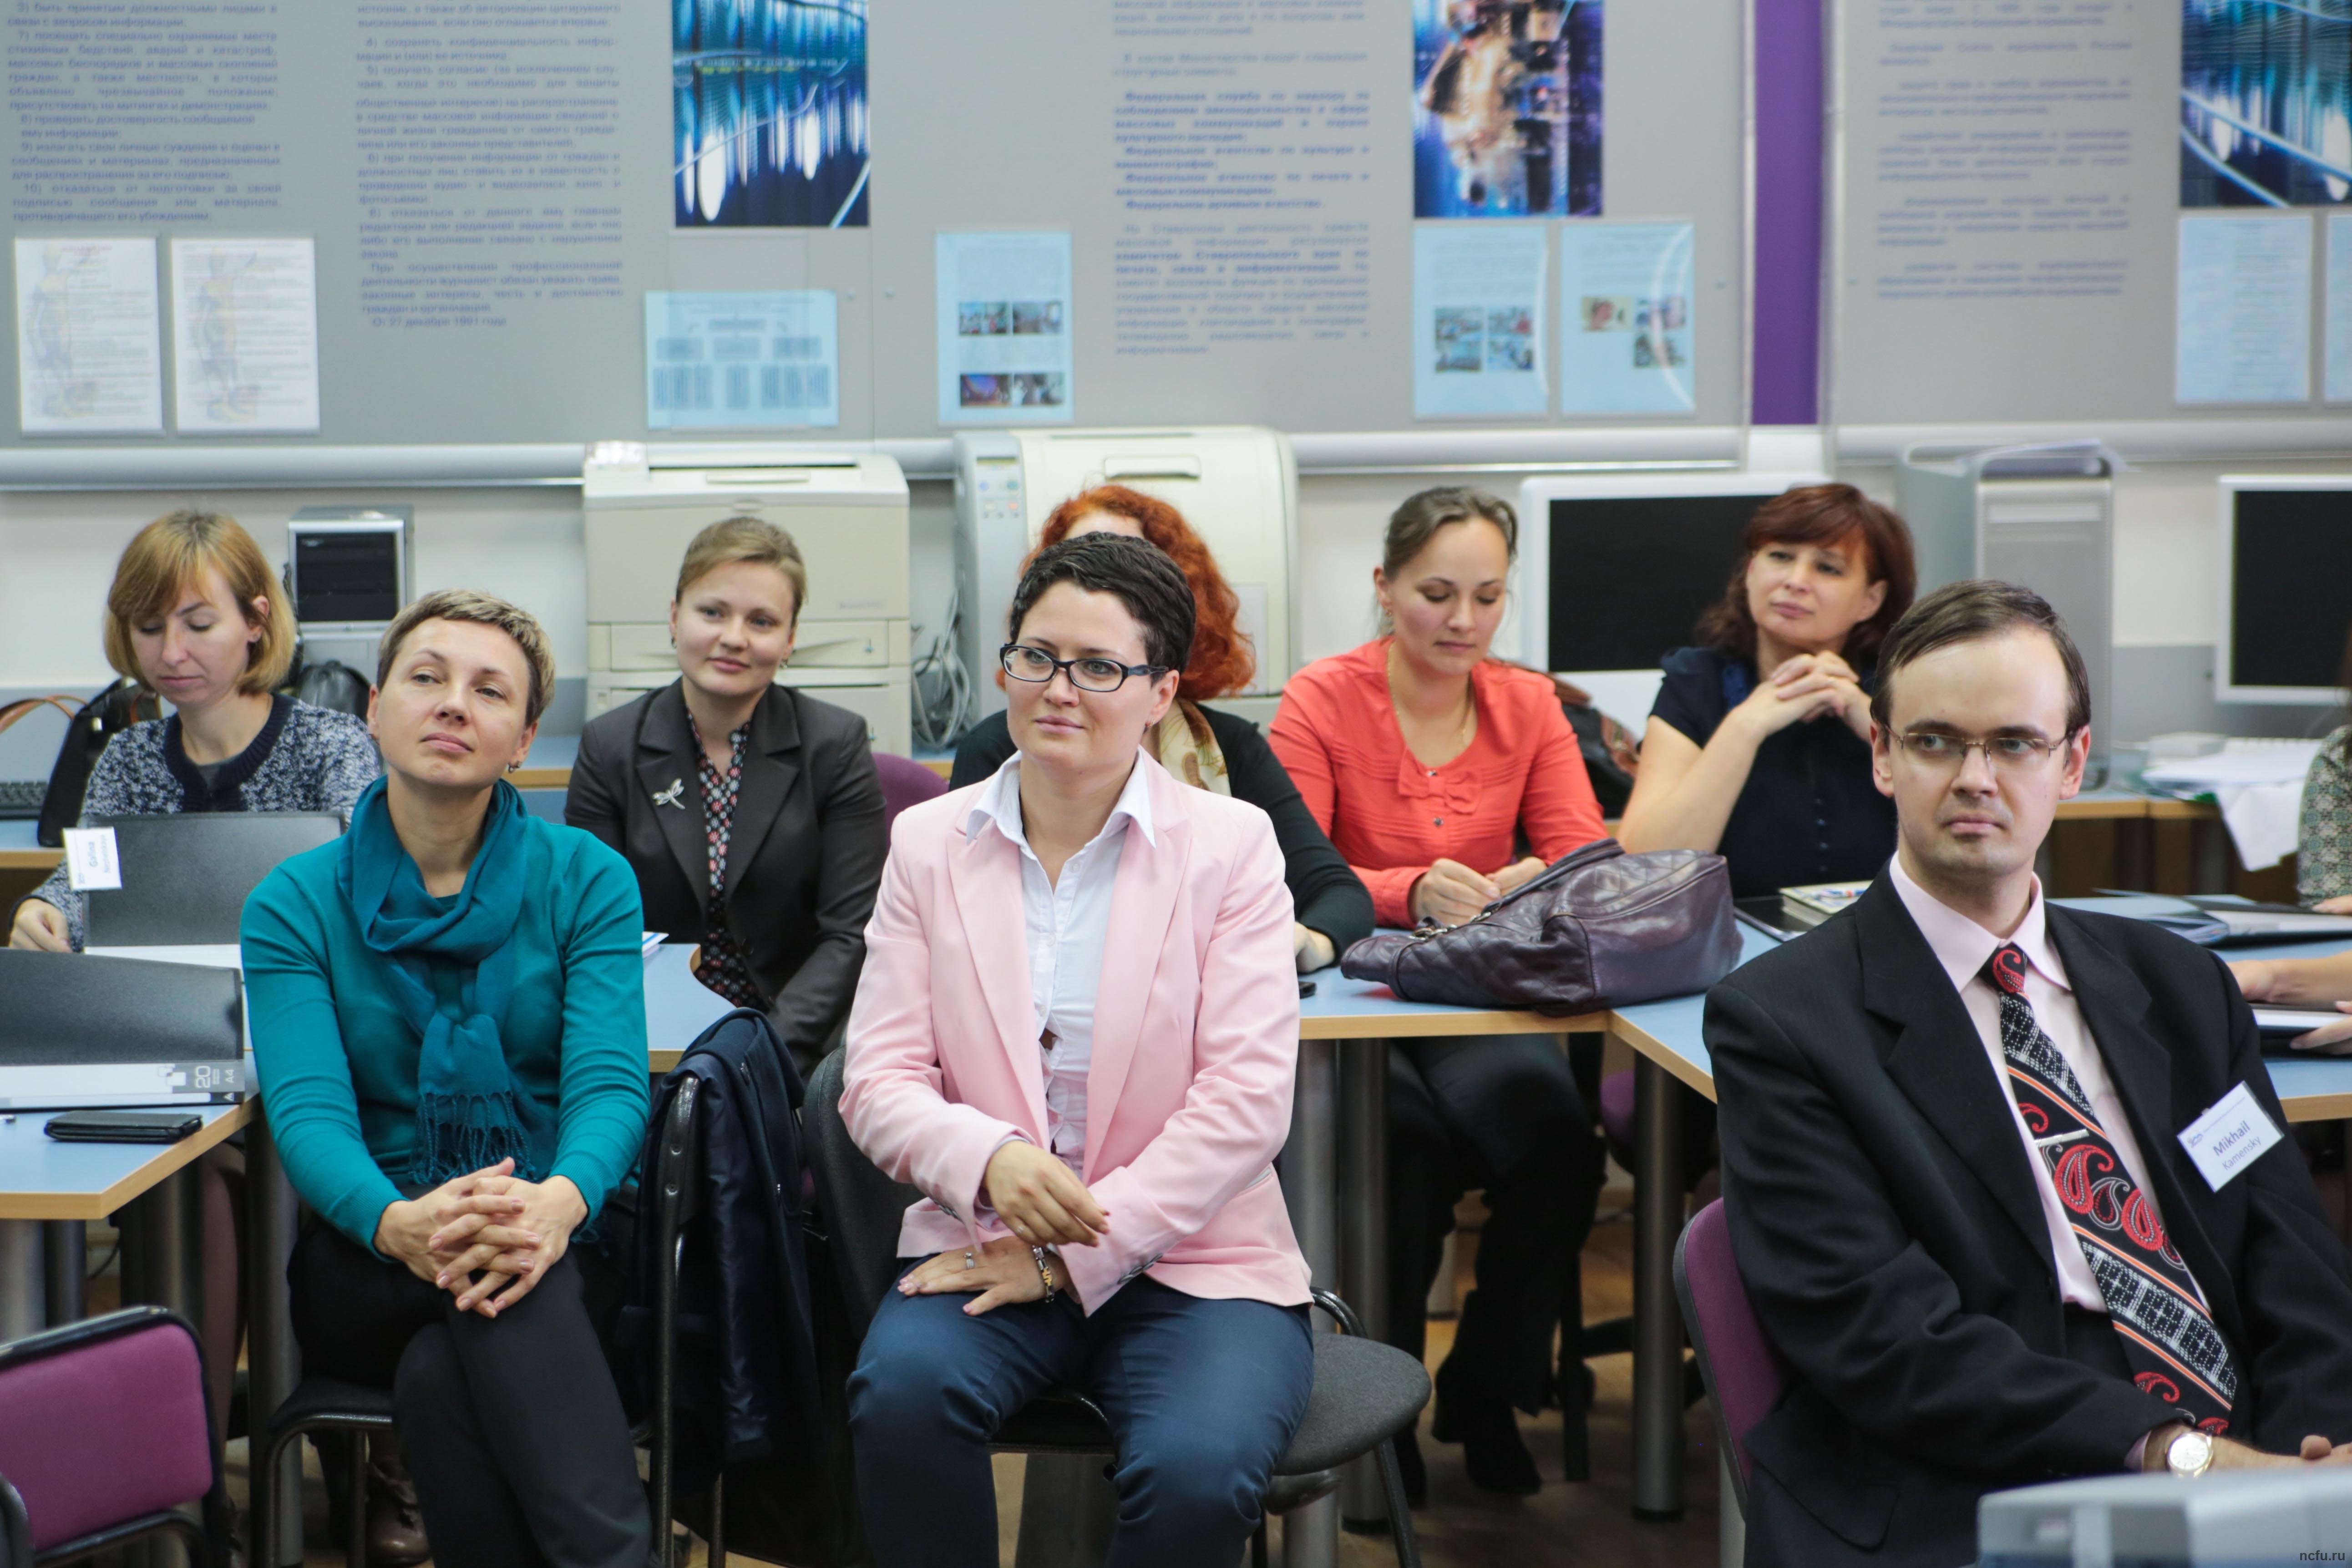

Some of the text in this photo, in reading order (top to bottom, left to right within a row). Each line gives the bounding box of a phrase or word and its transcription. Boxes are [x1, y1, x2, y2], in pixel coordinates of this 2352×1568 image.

[195, 1066, 211, 1088] 20
[225, 1069, 234, 1083] A4
[2213, 1121, 2250, 1156] Mikhail
[2222, 1136, 2261, 1170] Kamensky
